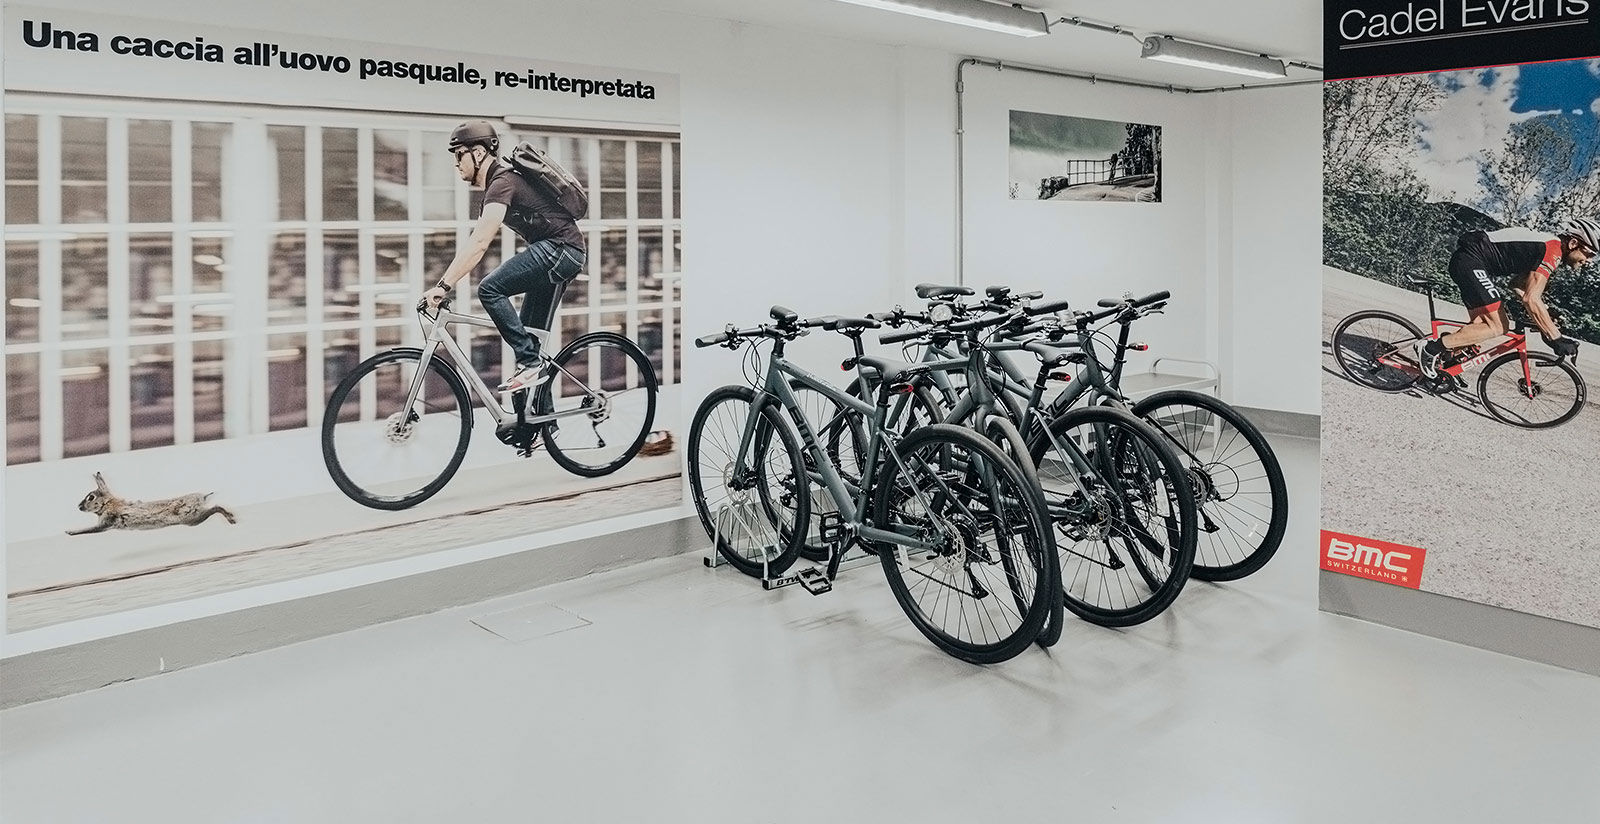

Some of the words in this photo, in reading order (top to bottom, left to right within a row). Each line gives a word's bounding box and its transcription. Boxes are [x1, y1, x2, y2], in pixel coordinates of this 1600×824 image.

[1339, 0, 1445, 41] Cadel
[1461, 0, 1590, 27] Evans
[23, 20, 99, 52] Una
[110, 35, 224, 63] caccia
[233, 42, 351, 74] all’uovo
[359, 58, 487, 90] pasquale,
[494, 69, 656, 100] re-interpretata
[1473, 269, 1501, 299] BMC
[788, 406, 825, 466] BMC
[1327, 538, 1411, 573] BMC
[1327, 560, 1397, 580] SWITZERLAND
